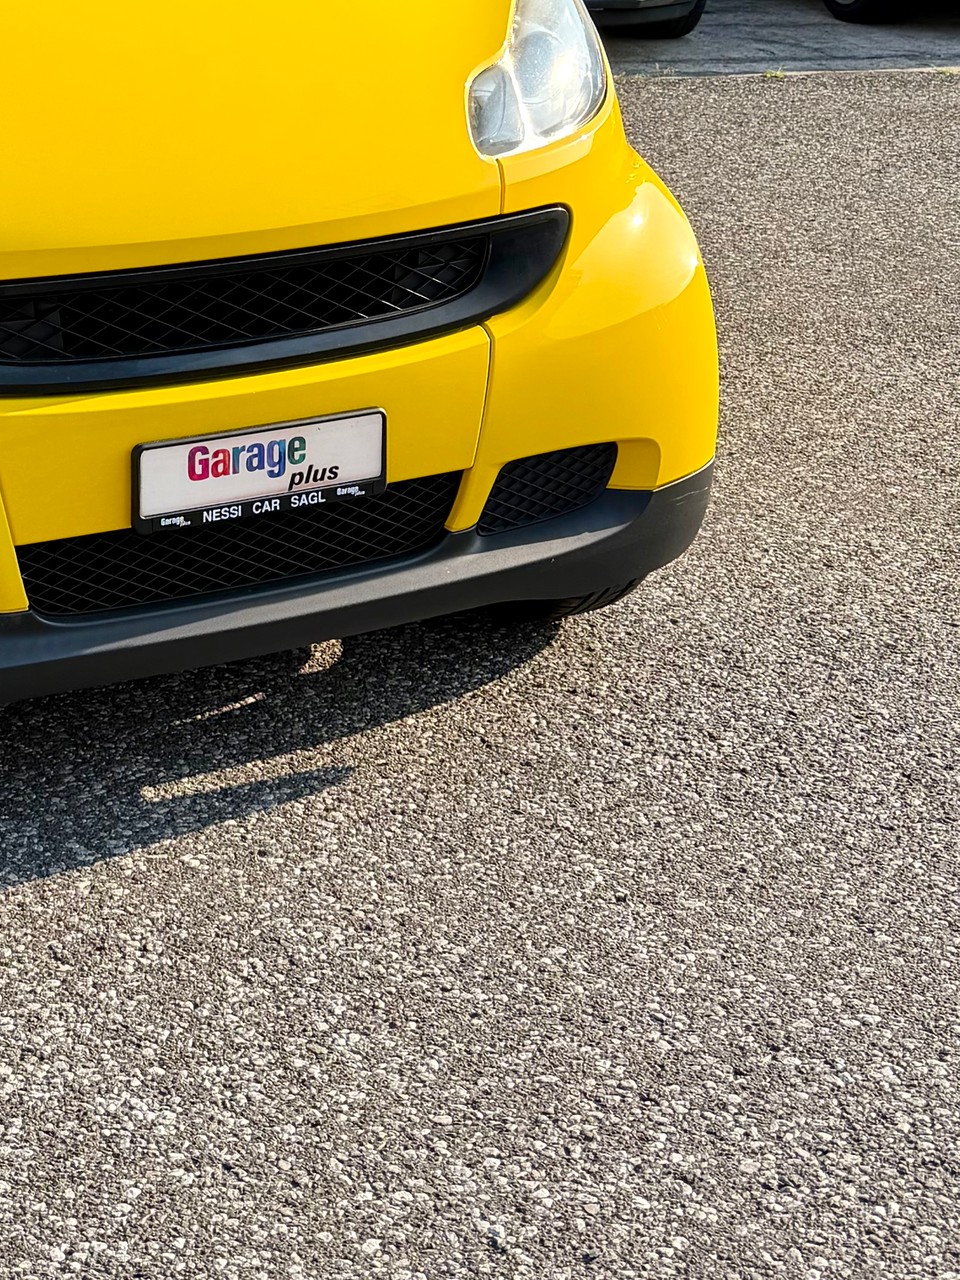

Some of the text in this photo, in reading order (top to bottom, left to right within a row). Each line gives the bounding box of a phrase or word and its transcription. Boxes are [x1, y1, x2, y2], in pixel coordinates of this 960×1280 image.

[187, 436, 307, 482] Garage
[288, 465, 340, 491] plus
[203, 491, 327, 523] NESSI CAR SAGL
